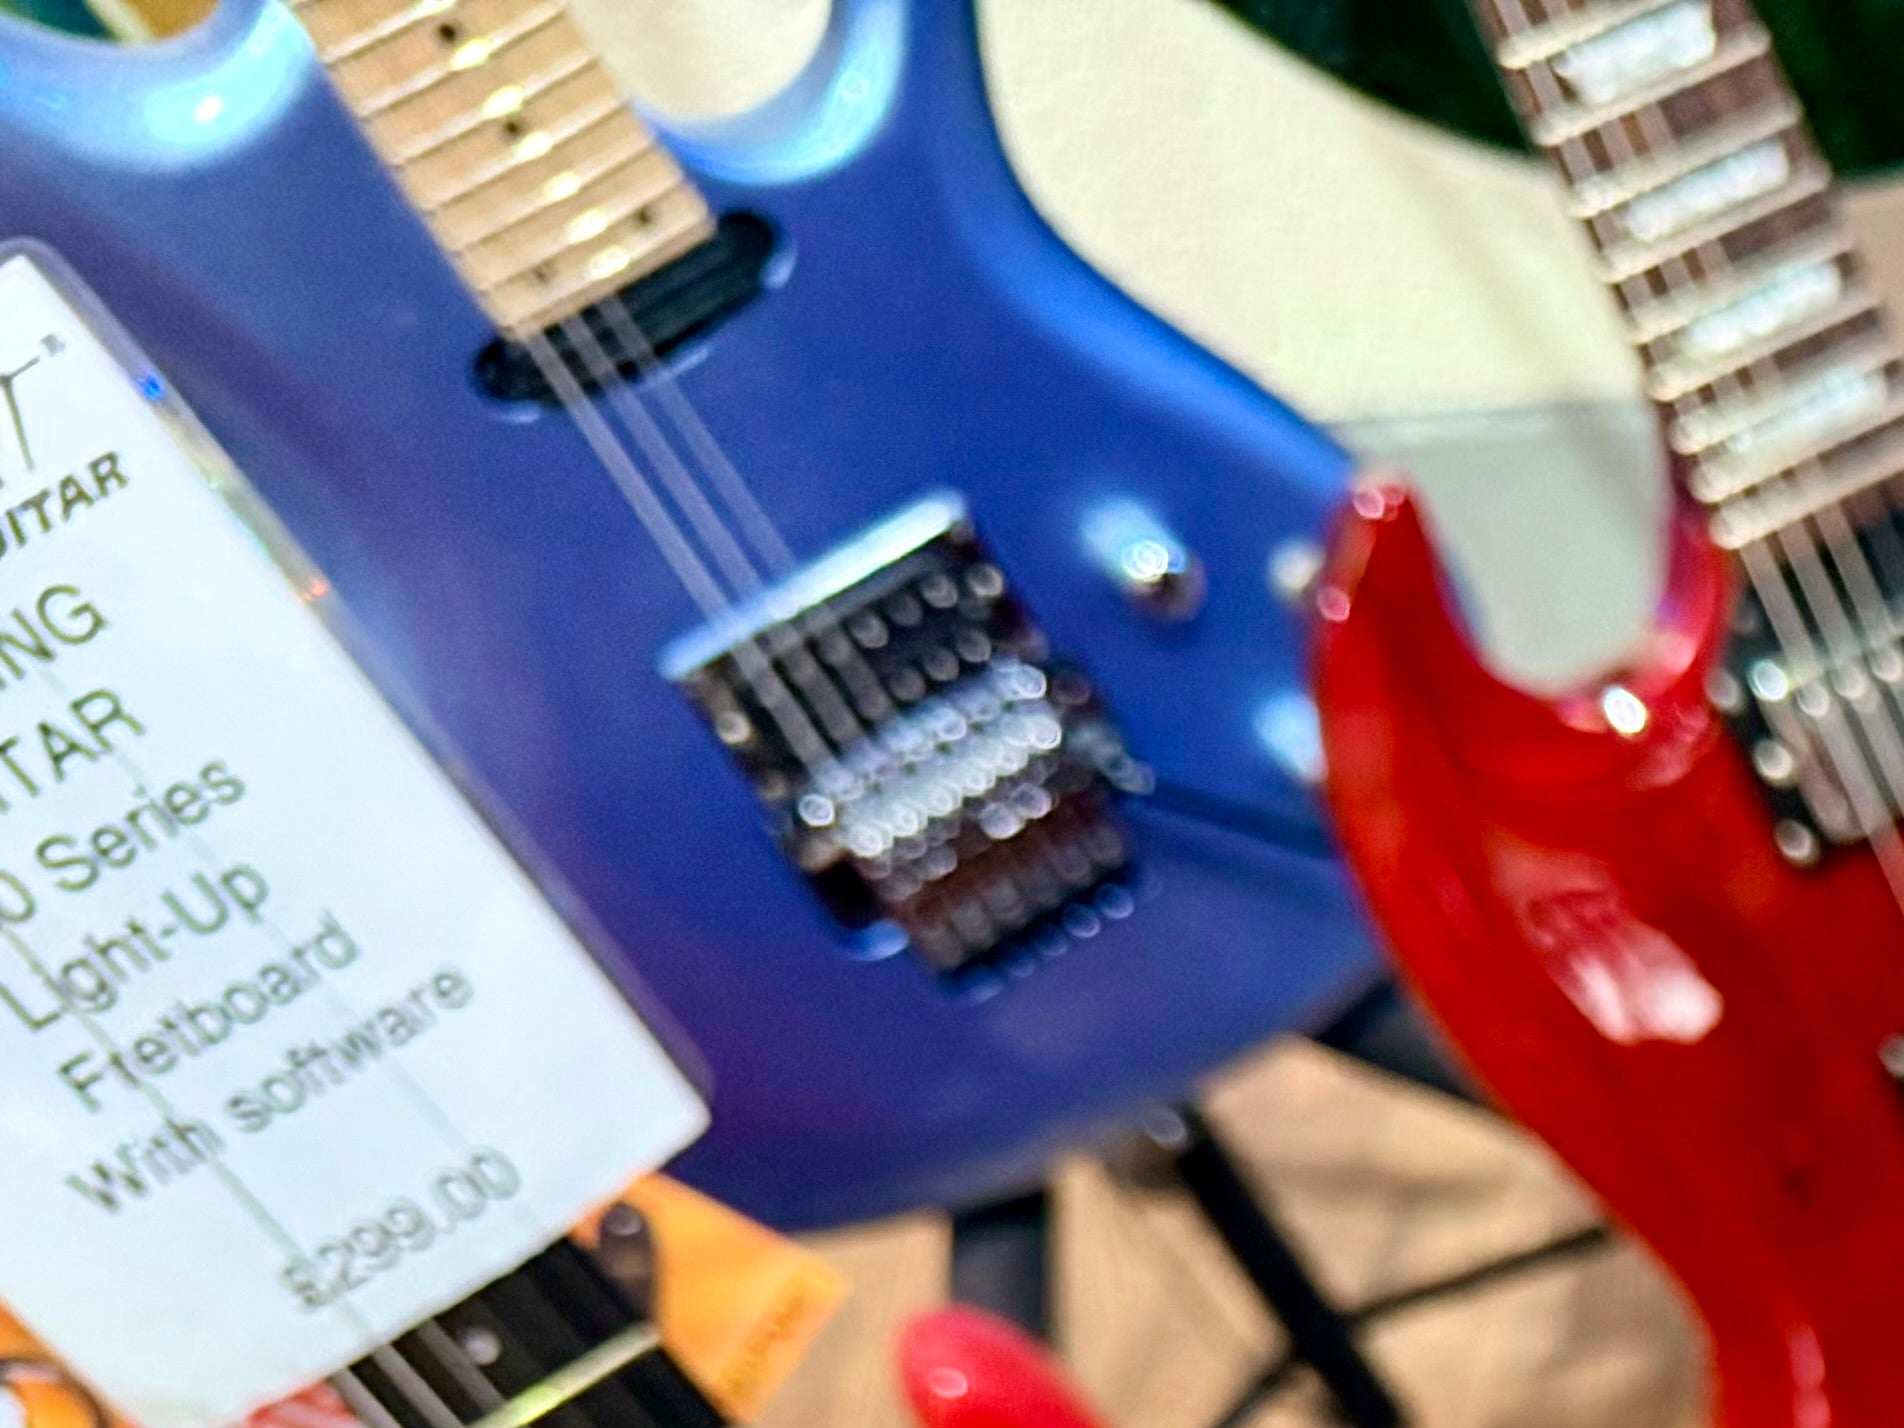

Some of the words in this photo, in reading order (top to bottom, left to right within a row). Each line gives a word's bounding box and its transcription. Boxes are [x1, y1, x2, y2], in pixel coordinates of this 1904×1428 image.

[0, 451, 129, 556] ITAR
[35, 760, 246, 893] Series
[57, 908, 362, 1113] Fretboard
[62, 1115, 228, 1215] With
